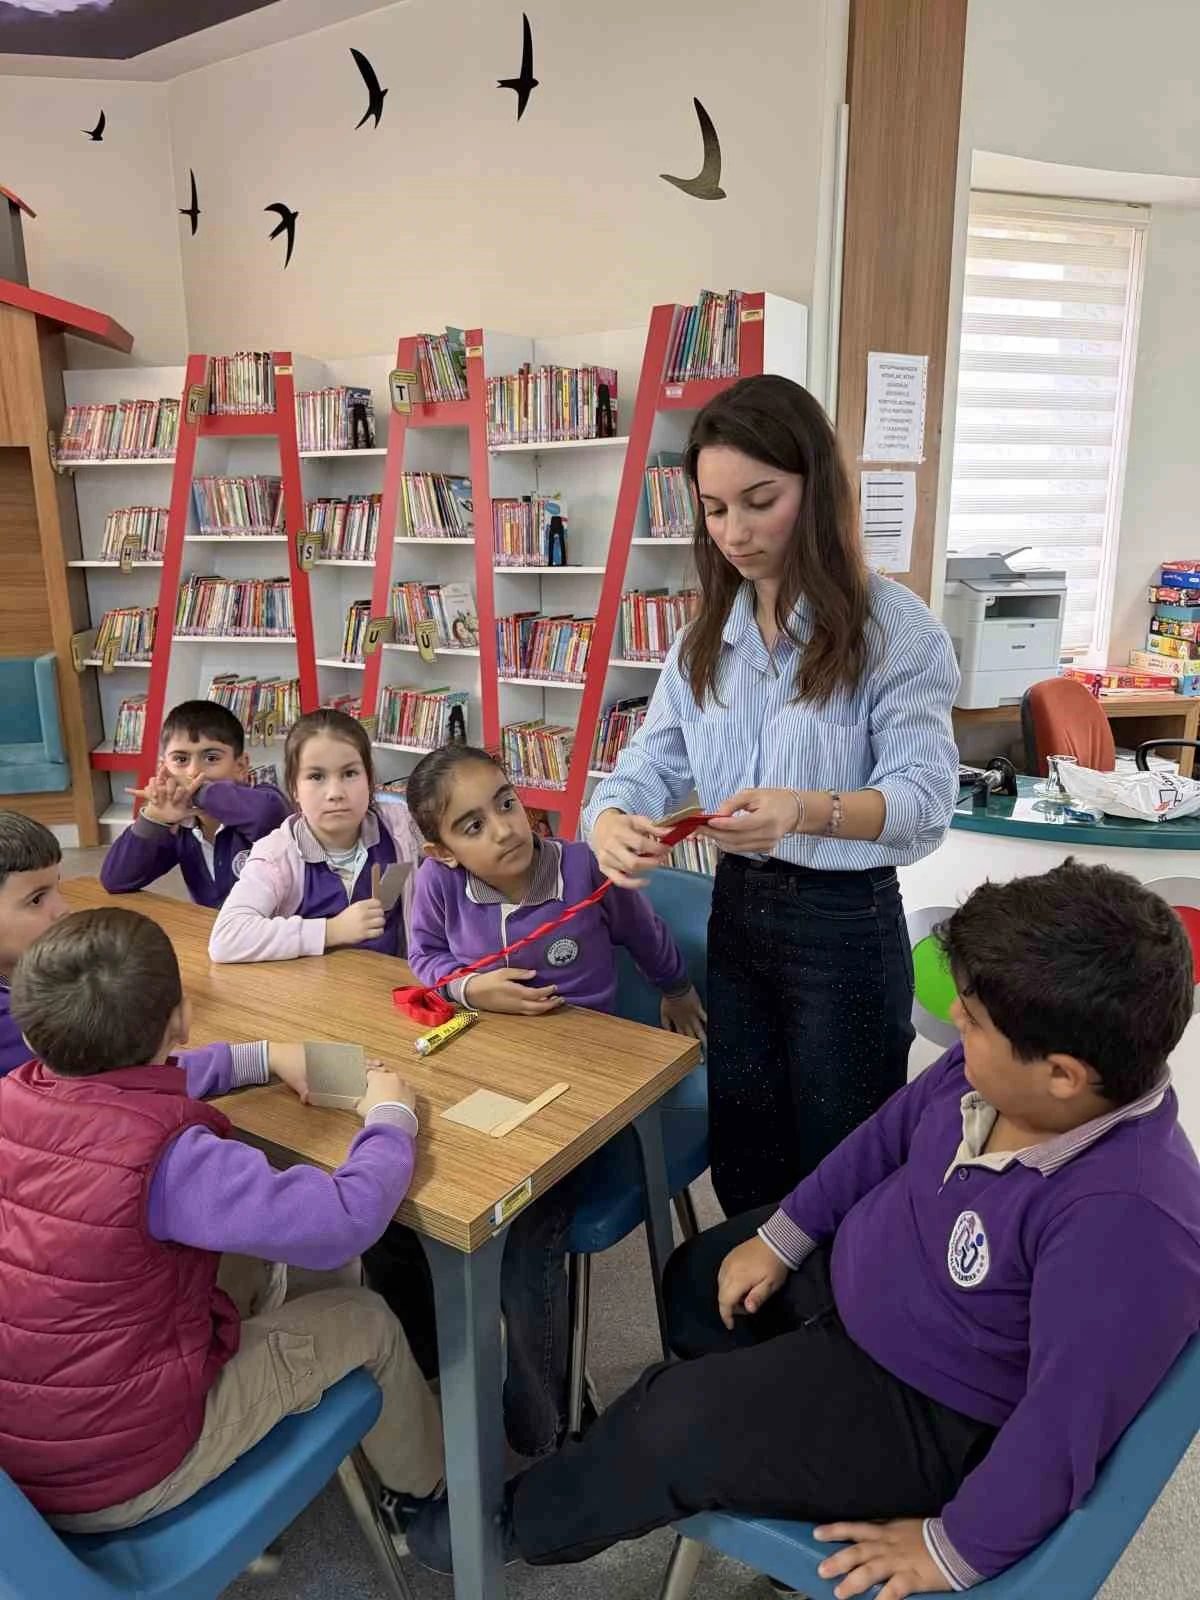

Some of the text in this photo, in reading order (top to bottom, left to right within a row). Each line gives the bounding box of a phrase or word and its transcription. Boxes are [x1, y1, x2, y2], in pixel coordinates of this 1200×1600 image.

[395, 385, 406, 400] T
[190, 399, 197, 412] K
[124, 547, 131, 560] H
[305, 545, 312, 560] S
[369, 630, 379, 643] U
[421, 631, 430, 648] Ü
